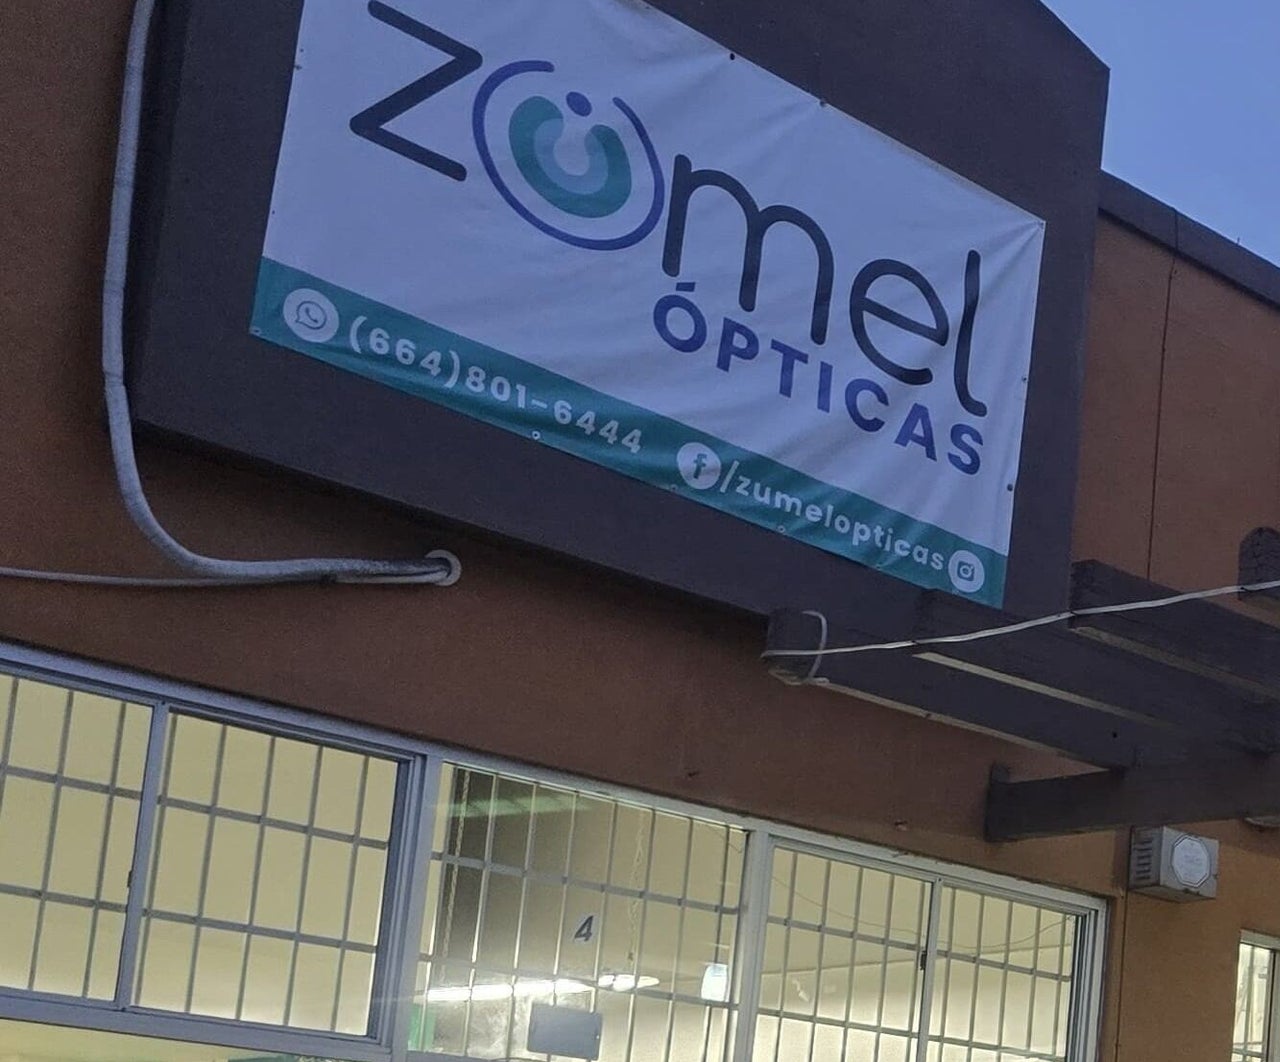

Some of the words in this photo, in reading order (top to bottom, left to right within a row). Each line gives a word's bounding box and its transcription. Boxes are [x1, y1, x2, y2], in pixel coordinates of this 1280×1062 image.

[349, 315, 643, 455] (664)801-6444
[652, 281, 983, 477] ÓPTICAS
[574, 915, 593, 942] 4
